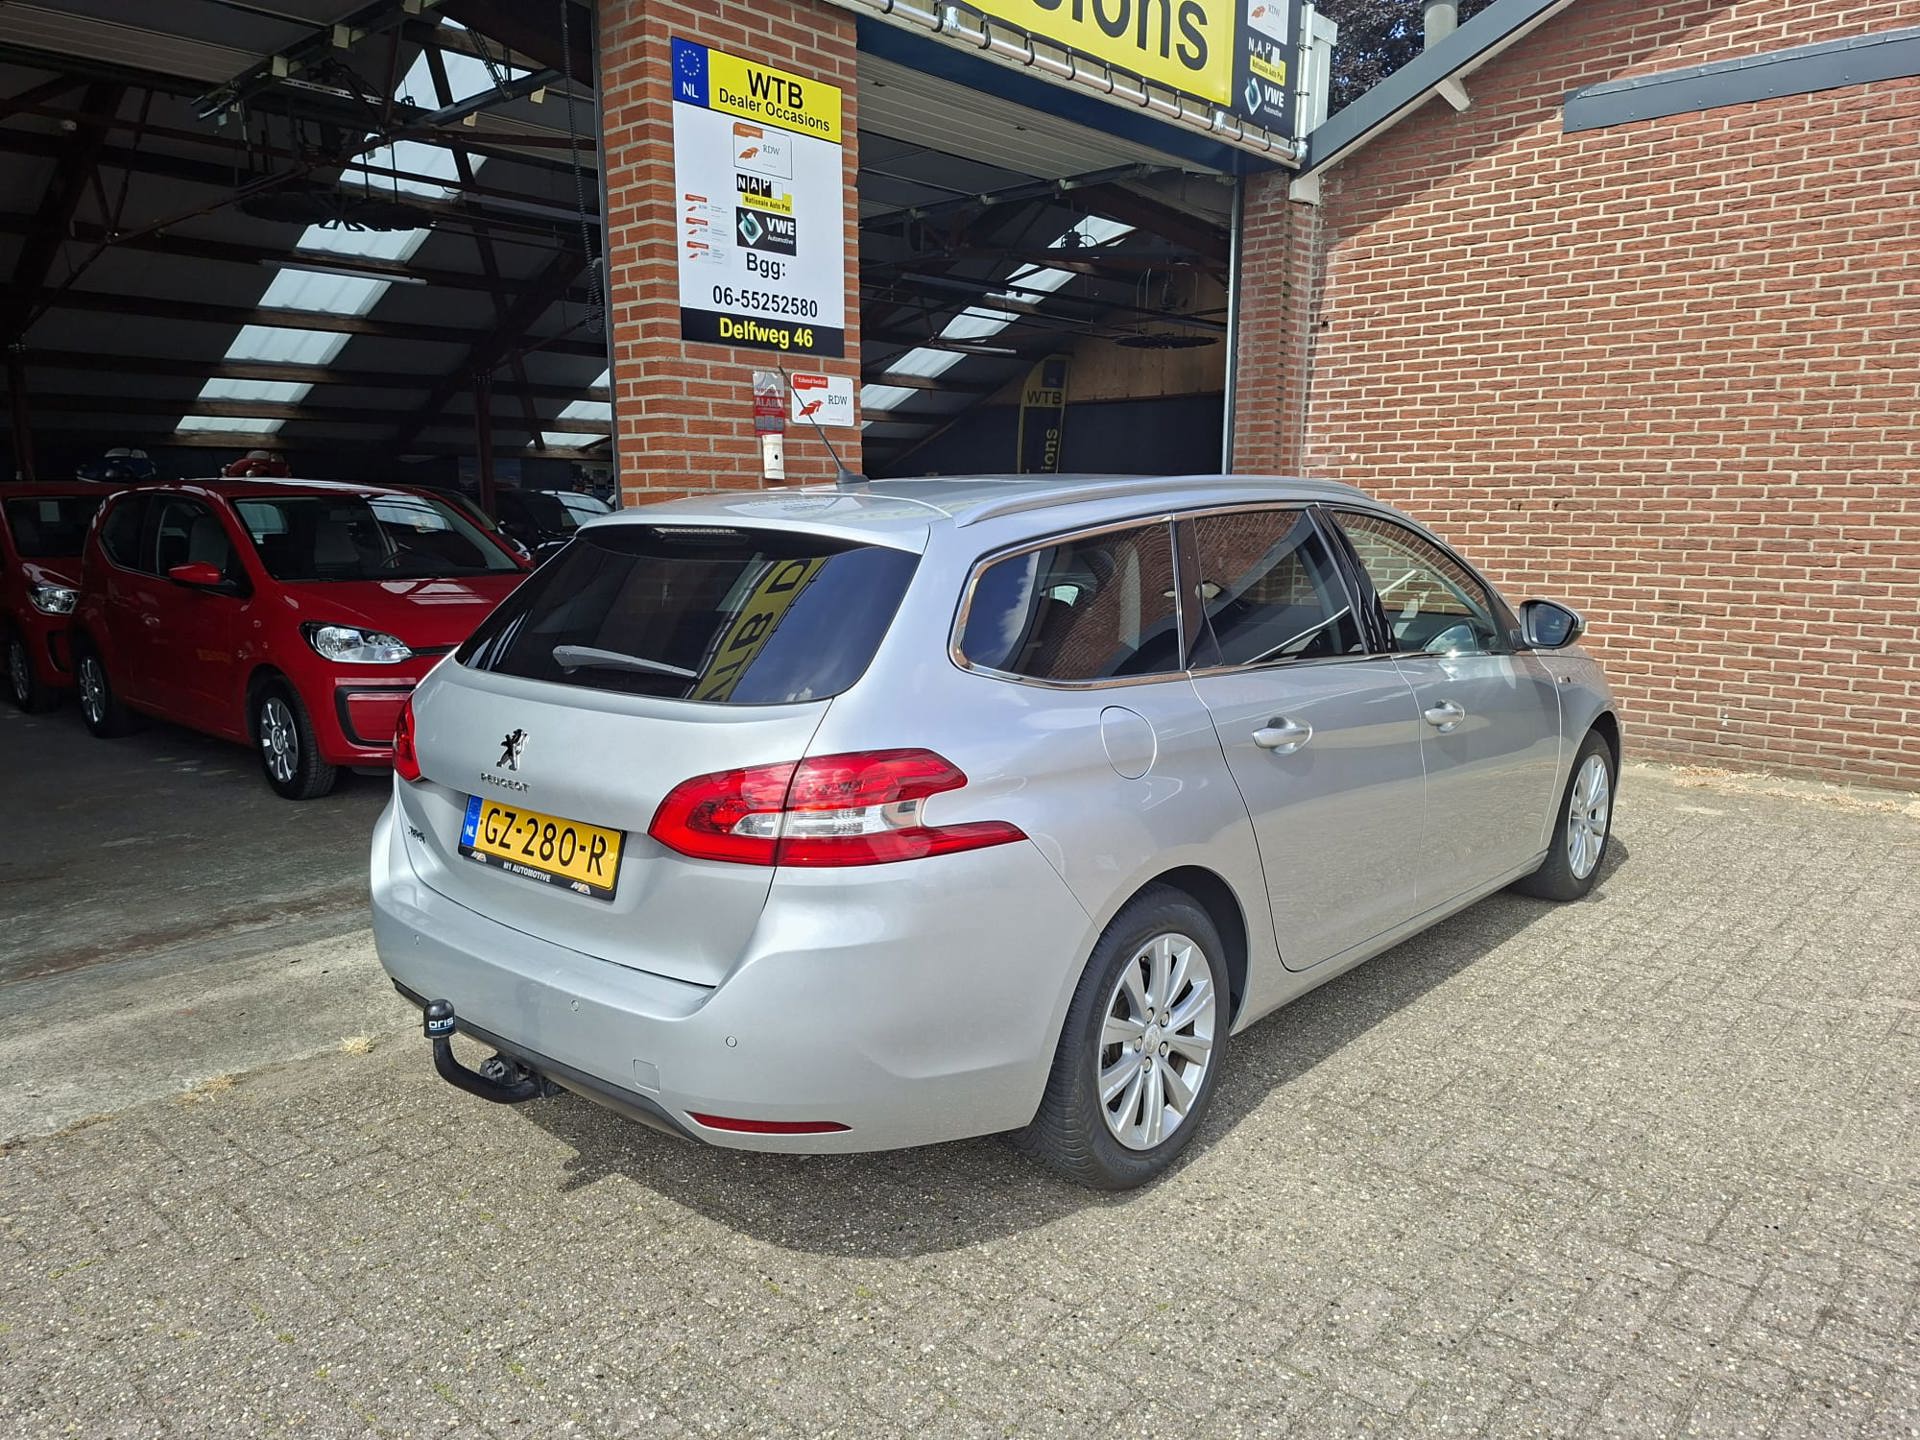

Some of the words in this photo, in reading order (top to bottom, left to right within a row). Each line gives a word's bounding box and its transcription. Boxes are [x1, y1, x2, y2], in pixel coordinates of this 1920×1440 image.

[682, 81, 699, 98] NL
[747, 69, 803, 109] WTB
[1265, 84, 1284, 108] VWE
[719, 88, 761, 113] Dealer
[765, 101, 830, 132] Occasions
[766, 217, 795, 236] VWE
[767, 234, 794, 245] Automotive
[746, 252, 786, 280] Bgg:
[713, 285, 818, 318] 06-55252580
[719, 317, 789, 349] Delfweg
[793, 327, 813, 348] 46
[828, 395, 847, 406] RDW
[1026, 390, 1062, 404] WTB
[480, 772, 531, 792] PEUGEOT
[465, 825, 475, 838] NL
[485, 807, 607, 876] GZ-280-R
[512, 864, 552, 882] AUTOMOTIVE
